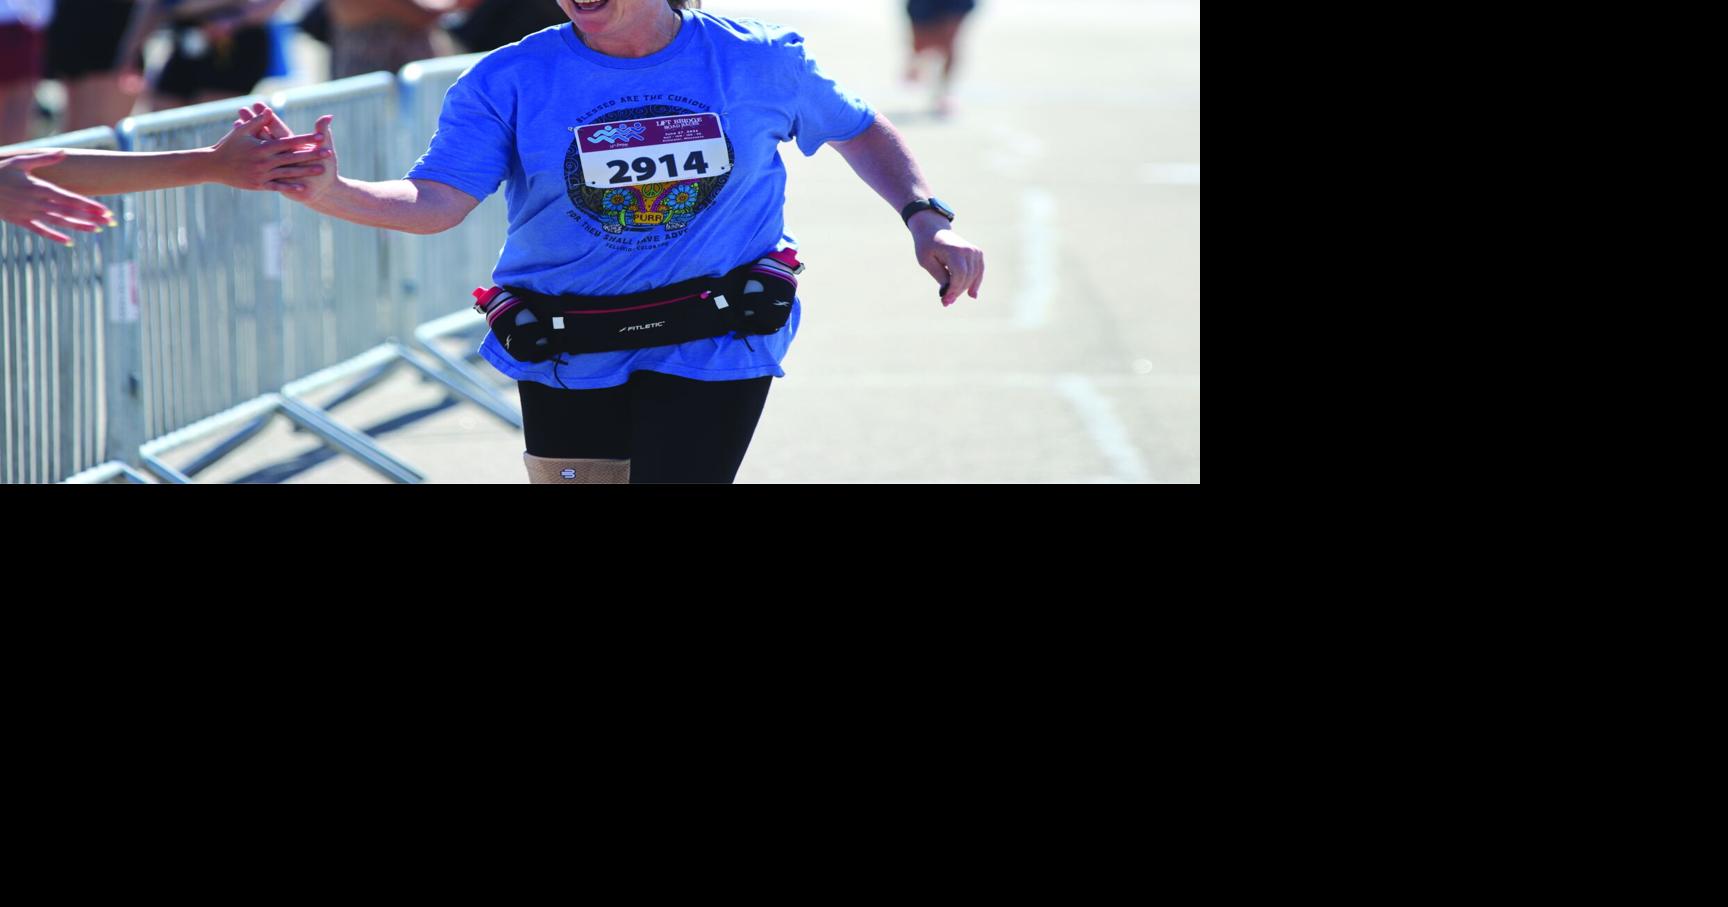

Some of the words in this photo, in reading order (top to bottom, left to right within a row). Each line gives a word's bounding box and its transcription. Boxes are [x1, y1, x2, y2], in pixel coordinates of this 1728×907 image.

[620, 95, 640, 103] ARE
[668, 94, 711, 112] CURIOUS
[606, 150, 709, 185] 2914
[567, 210, 582, 223] FOR
[603, 234, 632, 246] SHALL
[634, 213, 662, 222] PURR
